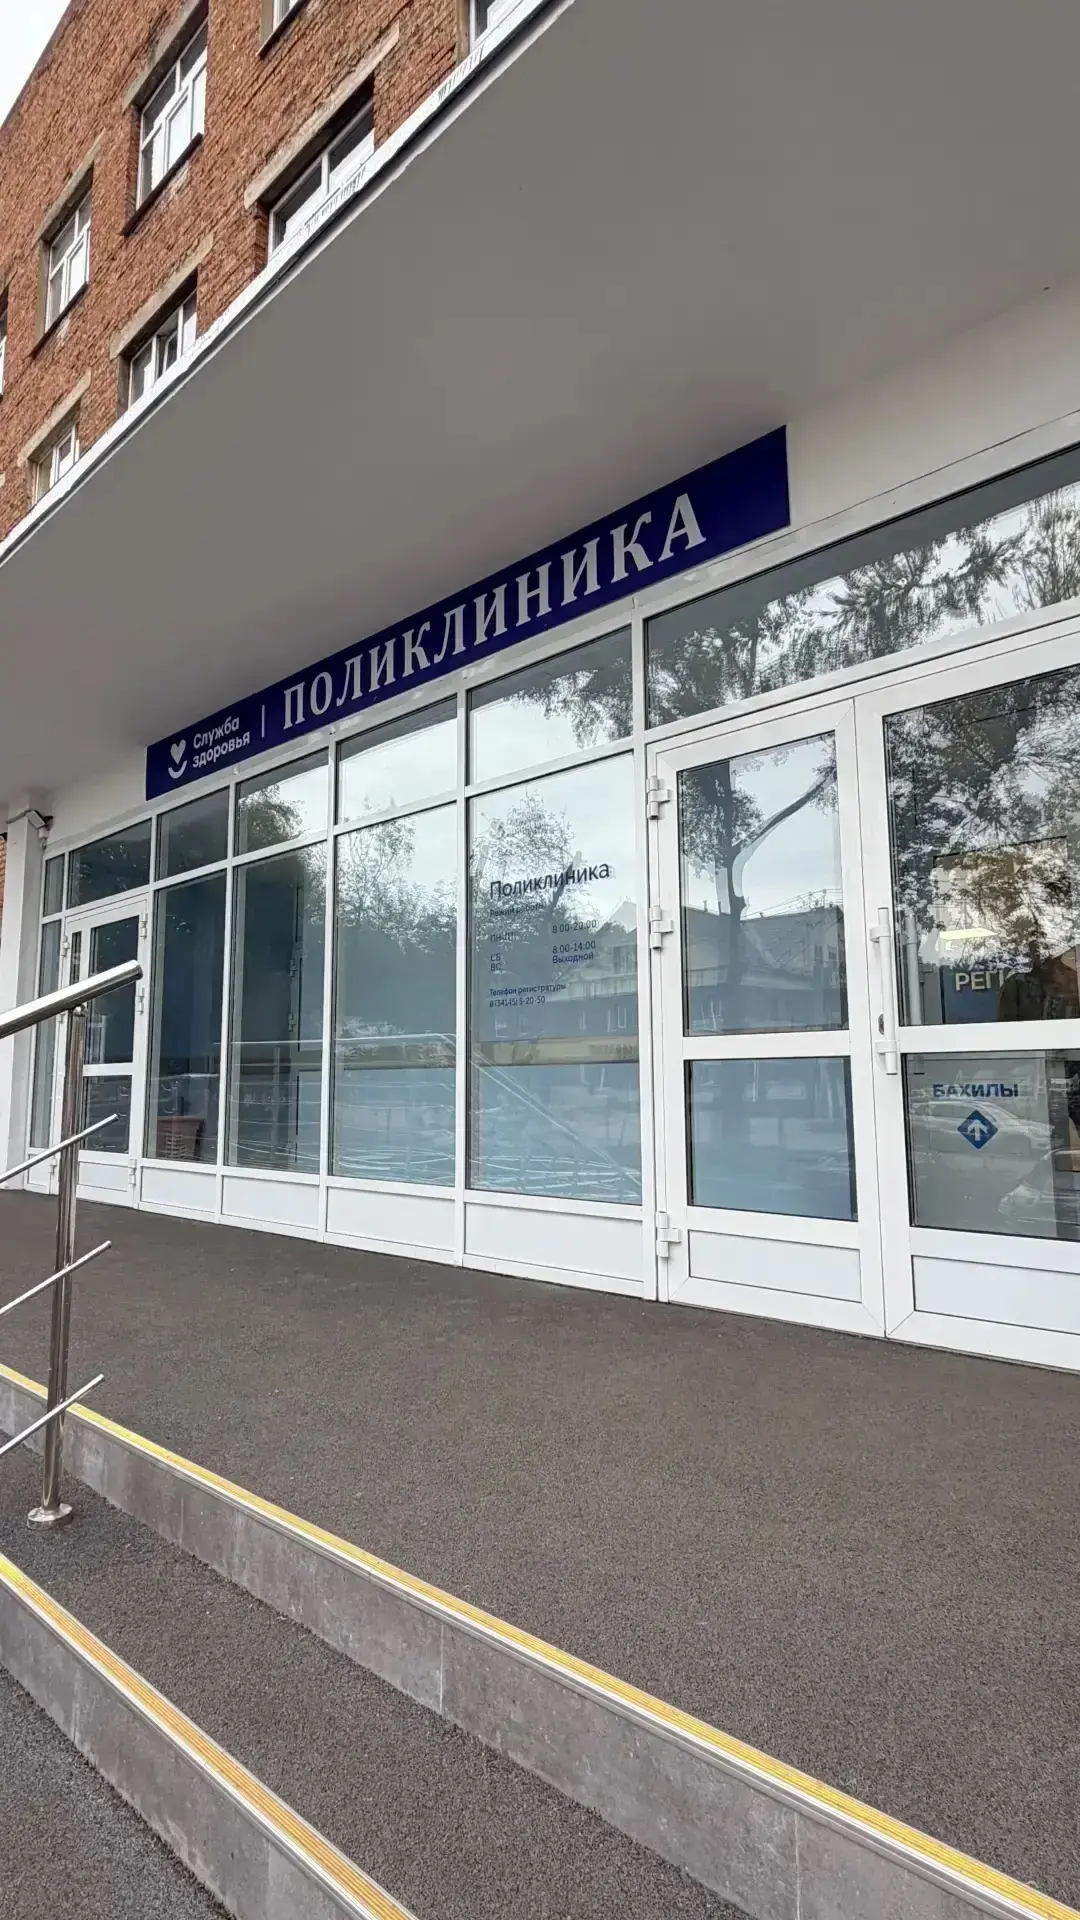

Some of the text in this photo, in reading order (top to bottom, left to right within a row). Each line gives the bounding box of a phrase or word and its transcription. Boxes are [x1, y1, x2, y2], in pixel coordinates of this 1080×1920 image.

[283, 493, 707, 730] ПОЛИКЛИНИКА
[193, 716, 240, 749] Служба
[192, 731, 251, 768] здоровья
[490, 863, 610, 899] Поликлиника
[552, 951, 594, 964] Выходной
[489, 983, 566, 997] Телефон регистратуры
[519, 996, 546, 1006] 5-20-50
[932, 1083, 1019, 1098] БАХИЛЫ
